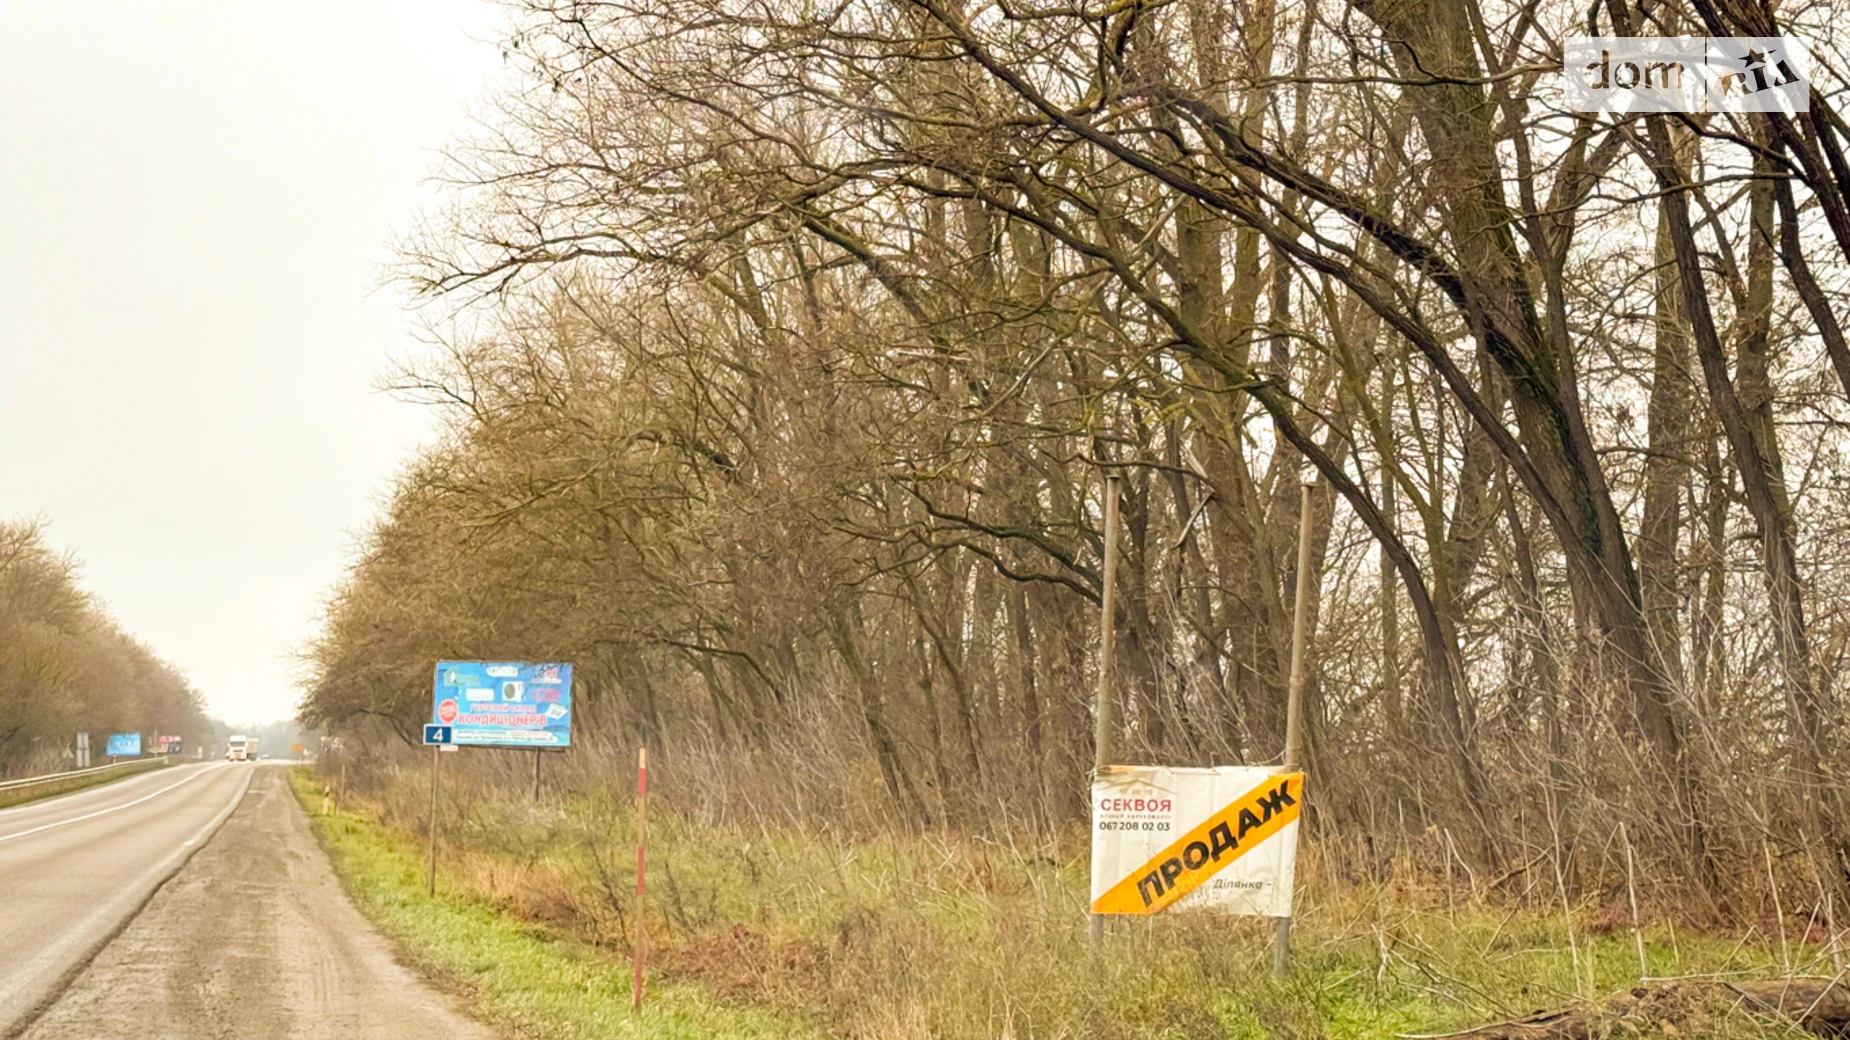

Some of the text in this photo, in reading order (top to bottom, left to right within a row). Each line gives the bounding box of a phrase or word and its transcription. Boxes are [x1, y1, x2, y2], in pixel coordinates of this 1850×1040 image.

[458, 713, 547, 726] КОНДИЦІОНЕРІВ
[432, 728, 444, 742] 4
[1100, 798, 1172, 813] СЕКВОЯ
[1099, 820, 1171, 832] 067 208 02 03
[1136, 778, 1297, 909] ПРОДАЖ
[1212, 878, 1263, 890] Ділянка
